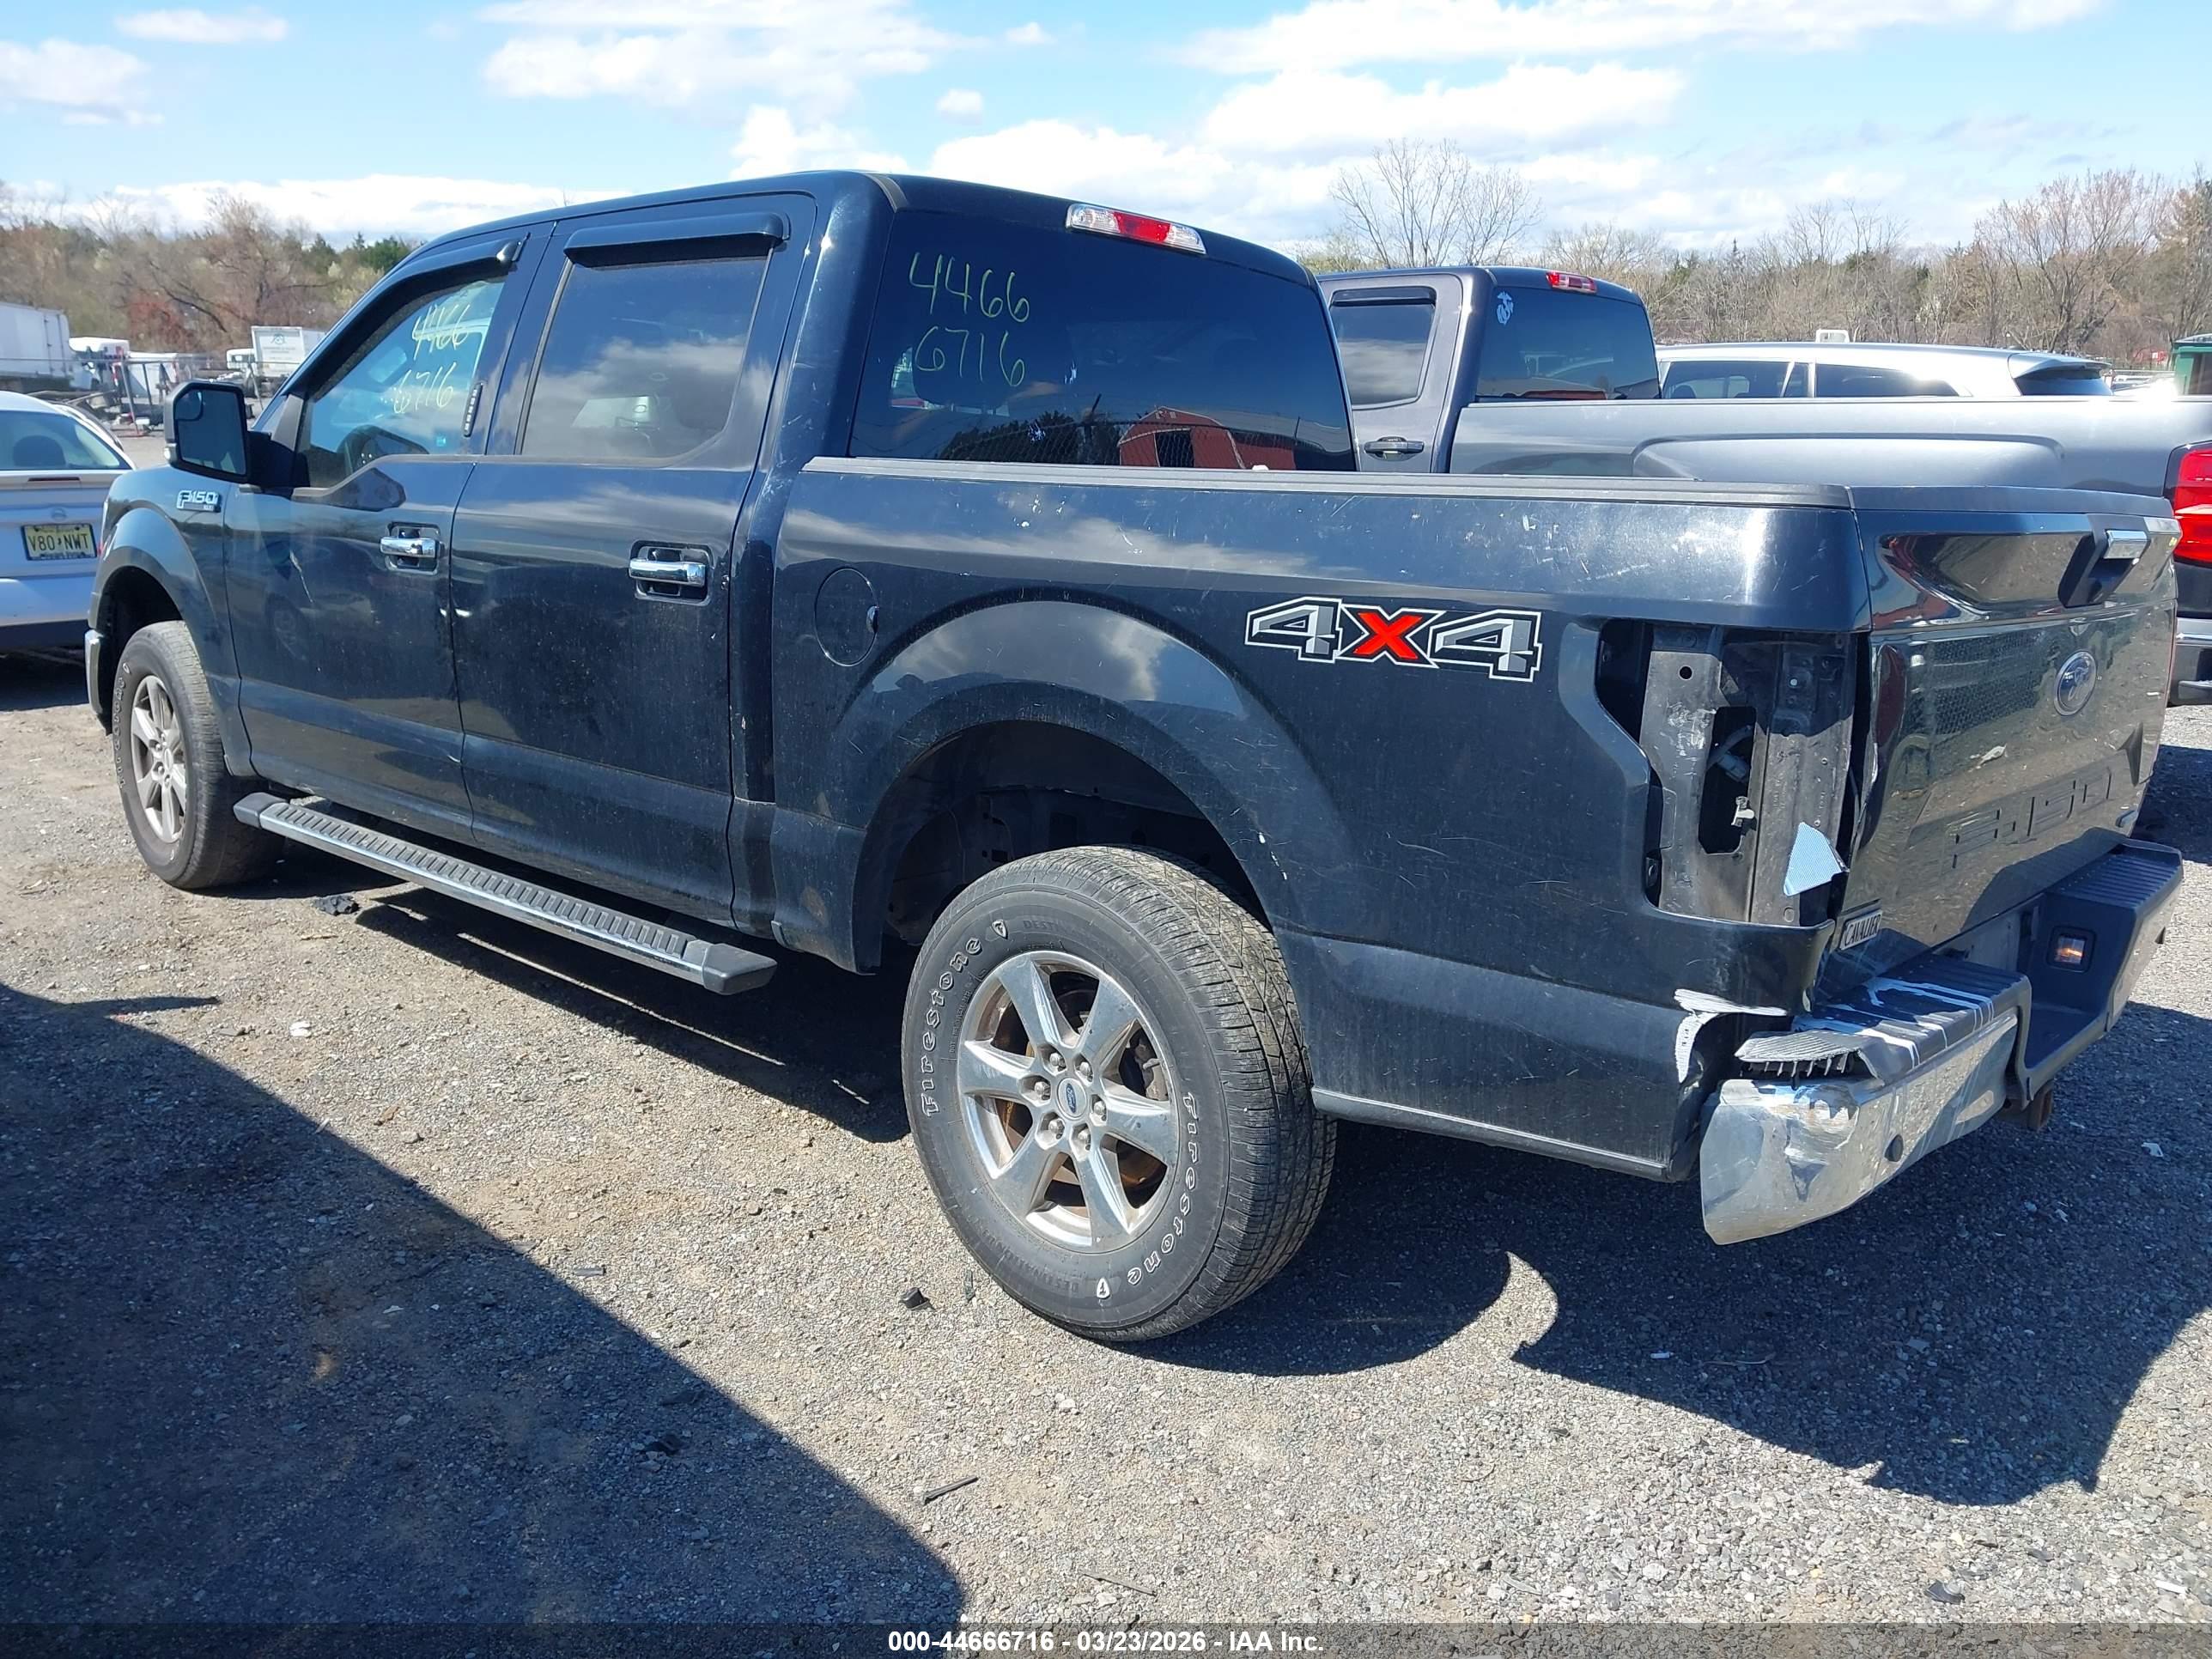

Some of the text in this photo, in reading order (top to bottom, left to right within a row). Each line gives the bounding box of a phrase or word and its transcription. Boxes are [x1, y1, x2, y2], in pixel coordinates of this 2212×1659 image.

[908, 252, 1030, 323] 4466
[412, 304, 471, 361] 4466
[915, 325, 1025, 387] 6716
[393, 362, 457, 414] 6716
[921, 936, 983, 1117] Firestone
[1127, 1091, 1199, 1285] Firestone
